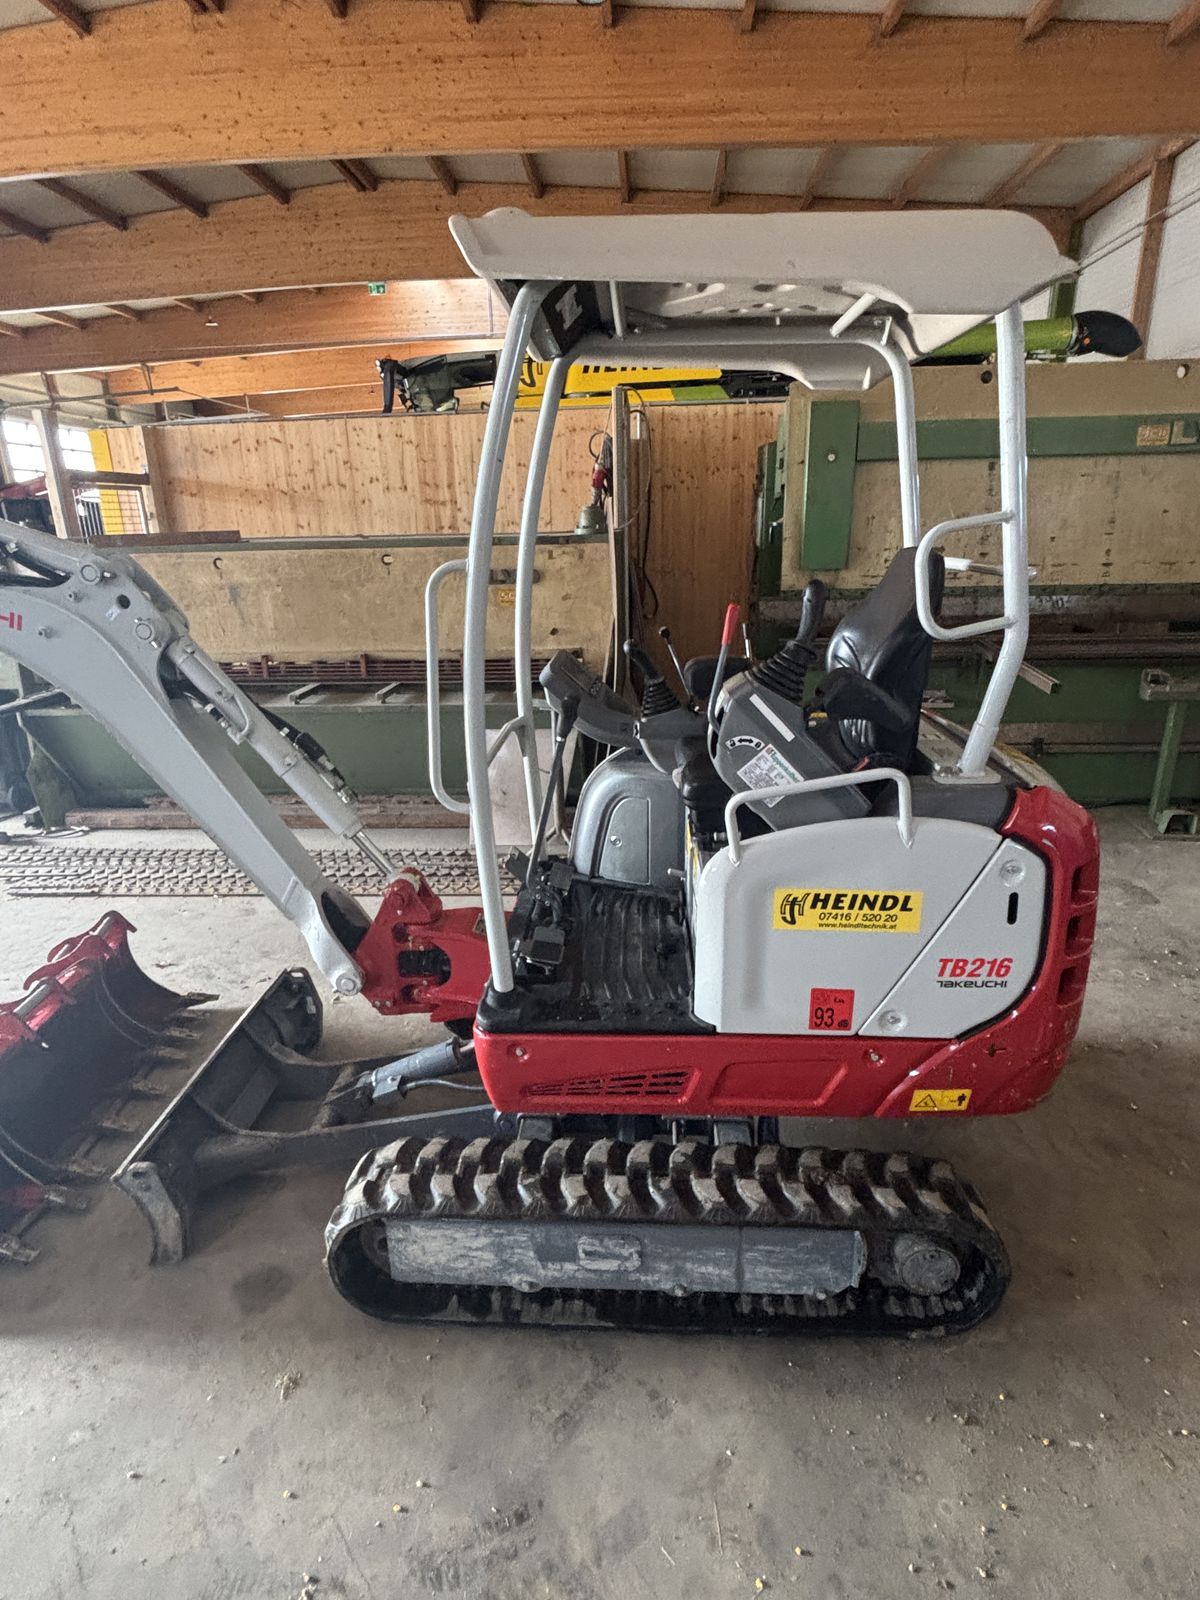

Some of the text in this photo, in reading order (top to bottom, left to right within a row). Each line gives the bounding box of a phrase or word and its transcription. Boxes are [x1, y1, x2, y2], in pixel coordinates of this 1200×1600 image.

[810, 893, 913, 912] HEINDL
[818, 912, 898, 922] 07416 / 520 20
[937, 957, 1014, 978] TB216
[814, 1007, 835, 1027] 93
